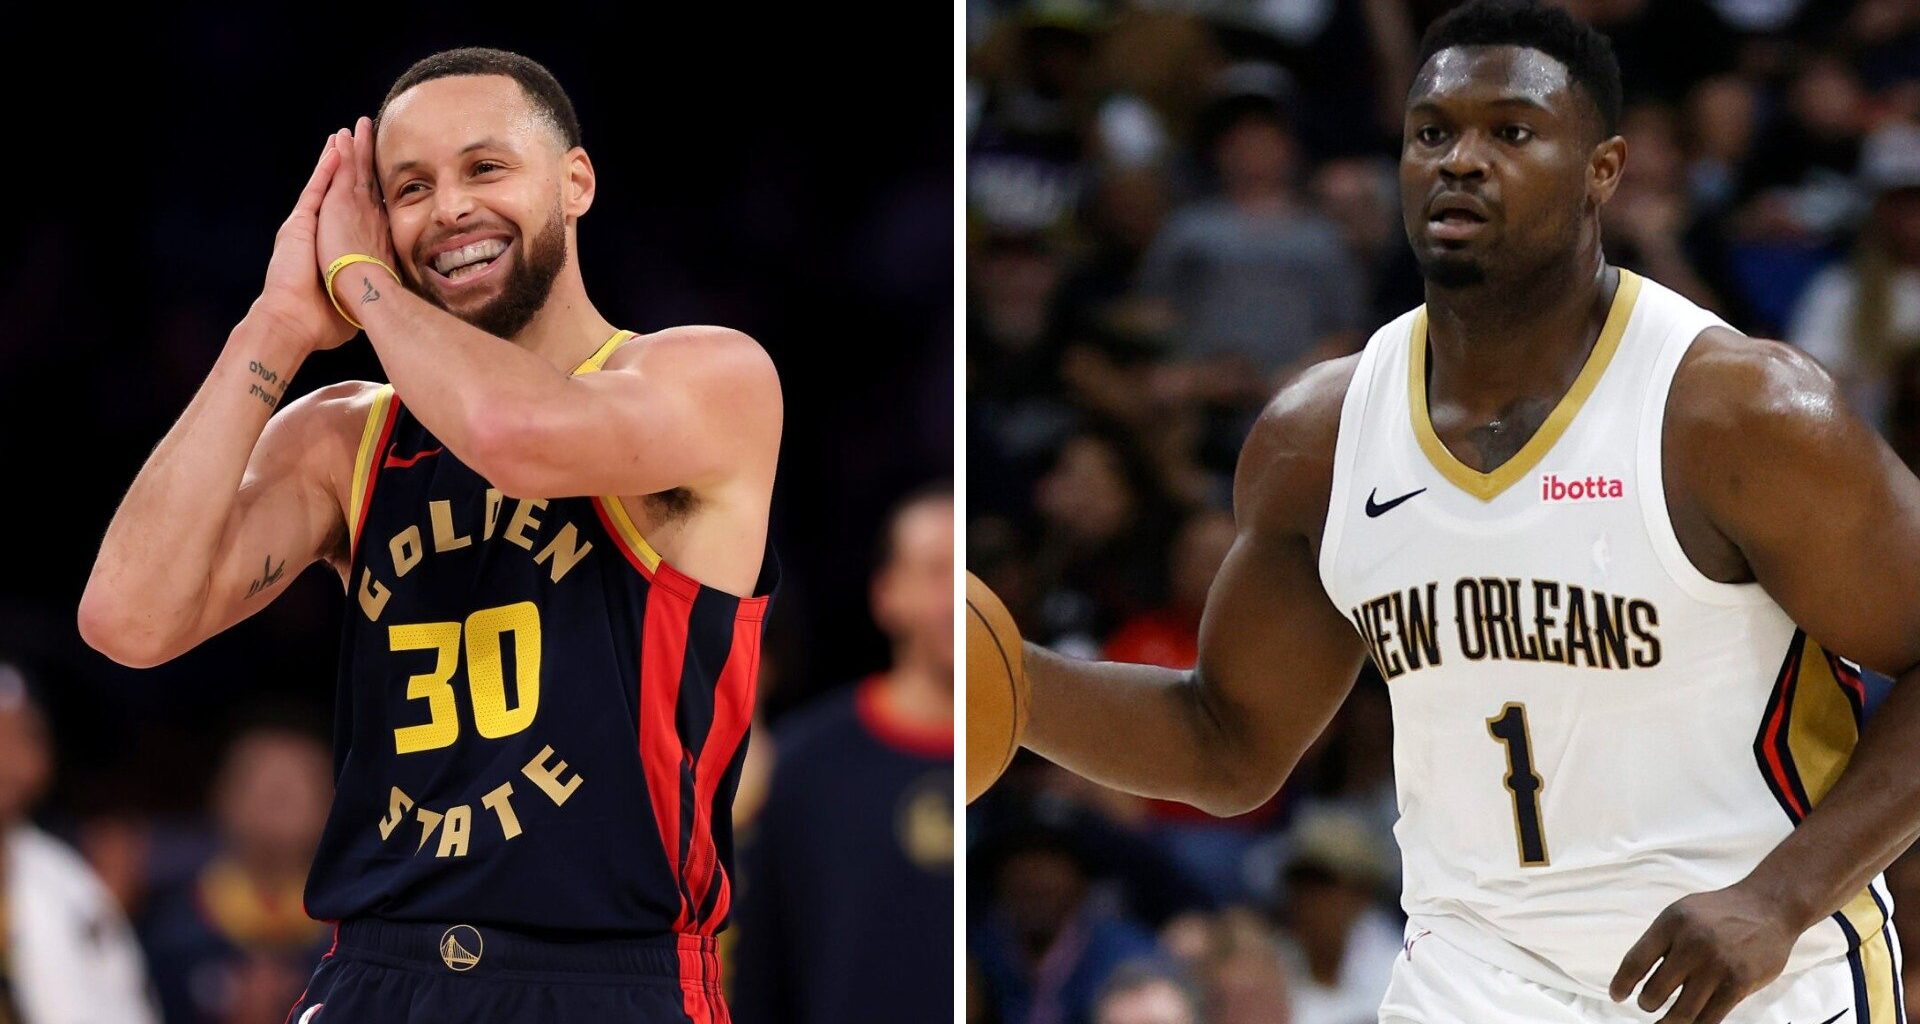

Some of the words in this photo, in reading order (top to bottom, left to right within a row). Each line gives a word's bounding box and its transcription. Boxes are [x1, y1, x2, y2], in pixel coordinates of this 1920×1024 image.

[1543, 475, 1624, 501] ibotta
[388, 600, 542, 755] 30
[1351, 581, 1443, 682] NEW
[1454, 577, 1663, 671] ORLEANS
[378, 744, 584, 858] STATE
[1485, 701, 1551, 868] 1
